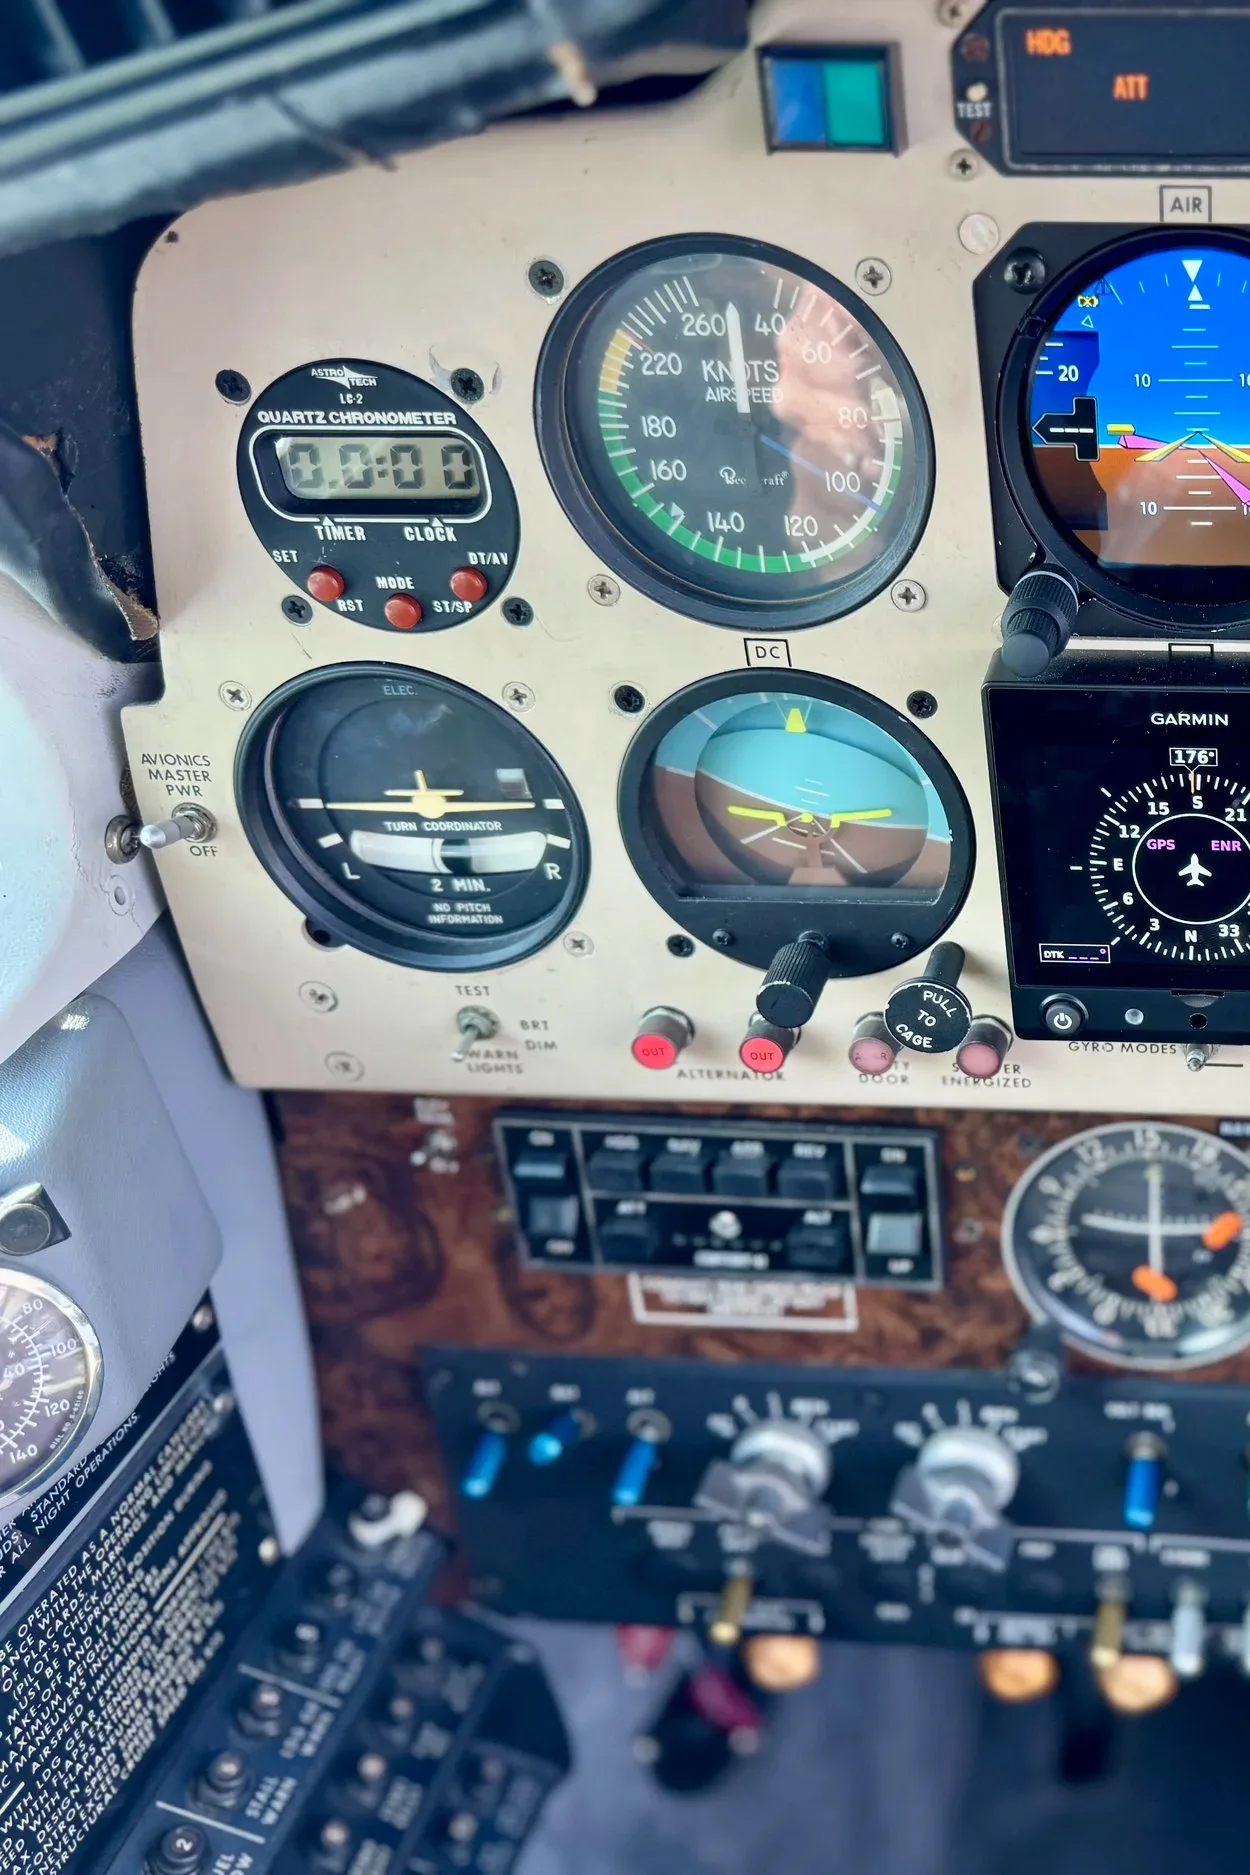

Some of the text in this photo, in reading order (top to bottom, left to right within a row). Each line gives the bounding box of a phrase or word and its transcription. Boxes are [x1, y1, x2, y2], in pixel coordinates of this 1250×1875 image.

[1026, 29, 1071, 56] HDG
[1112, 74, 1149, 100] ATT
[957, 103, 991, 119] TEST
[1169, 196, 1203, 215] AIR
[683, 314, 726, 337] 260
[755, 314, 787, 336] 40
[801, 341, 832, 364] 60
[640, 352, 682, 376] 220
[311, 368, 378, 387] ASTRO TECH
[1058, 365, 1079, 382] 20
[1133, 373, 1151, 388] 10
[257, 411, 457, 426] QUARTZ CHRONOMETER
[838, 406, 867, 429] 80
[642, 416, 677, 438] 180
[651, 460, 687, 481] 160
[824, 471, 861, 493] 100
[1140, 501, 1157, 516] 10
[707, 512, 745, 534] 140
[784, 516, 819, 538] 120
[314, 525, 457, 543] TIMER CLOCK
[272, 550, 299, 563] SET
[375, 575, 415, 590] MODE
[337, 599, 365, 612] RST
[432, 599, 473, 614] ST/SP
[755, 644, 782, 660] DC
[1150, 712, 1229, 728] GARMIN
[140, 753, 212, 768] AVIONICS
[148, 768, 213, 783] MASTER
[165, 783, 203, 798] PWR
[1147, 802, 1170, 816] 15
[1225, 808, 1247, 822] 21
[384, 820, 503, 833] TURN COORDINATOR
[1119, 825, 1141, 840] 12
[189, 844, 219, 859] OFF
[1146, 839, 1242, 852] GPS ENR
[430, 878, 492, 893] 2 MIN.
[432, 902, 492, 914] NO PITCH
[427, 913, 504, 926] INFORMATION
[1218, 924, 1240, 938] 33
[1043, 949, 1064, 960] DTK
[454, 984, 491, 997] TEST
[922, 989, 957, 1019] PULL
[519, 1019, 550, 1032] BRT
[917, 1009, 937, 1028] TO
[894, 1022, 934, 1049] CAGE
[524, 1039, 559, 1052] DIM
[641, 1046, 666, 1059] OUT
[1068, 1041, 1177, 1055] GYRO MODES
[749, 1050, 775, 1062] OUT
[466, 1062, 524, 1075] LIGHTS
[22, 1299, 43, 1314] 80
[50, 1338, 77, 1356] 100
[45, 1400, 70, 1417] 120
[10, 1444, 38, 1464] 140
[34, 1489, 71, 1535] NIGHT
[18, 1564, 78, 1637] OPERATED
[38, 1563, 92, 1630] WITH THE
[63, 1590, 99, 1638] CHECK
[7, 1574, 126, 1725] MUST UPRIGHT
[68, 1636, 93, 1671] AND
[65, 1630, 110, 1689] WEIGHT
[15, 1679, 88, 1773] MANEUVERS
[31, 1704, 84, 1774] AIRSPEED
[0, 1709, 96, 1834] WITH LDG GEAR
[17, 1740, 86, 1831] WITH FLAPS
[36, 1783, 80, 1844] DESIGN
